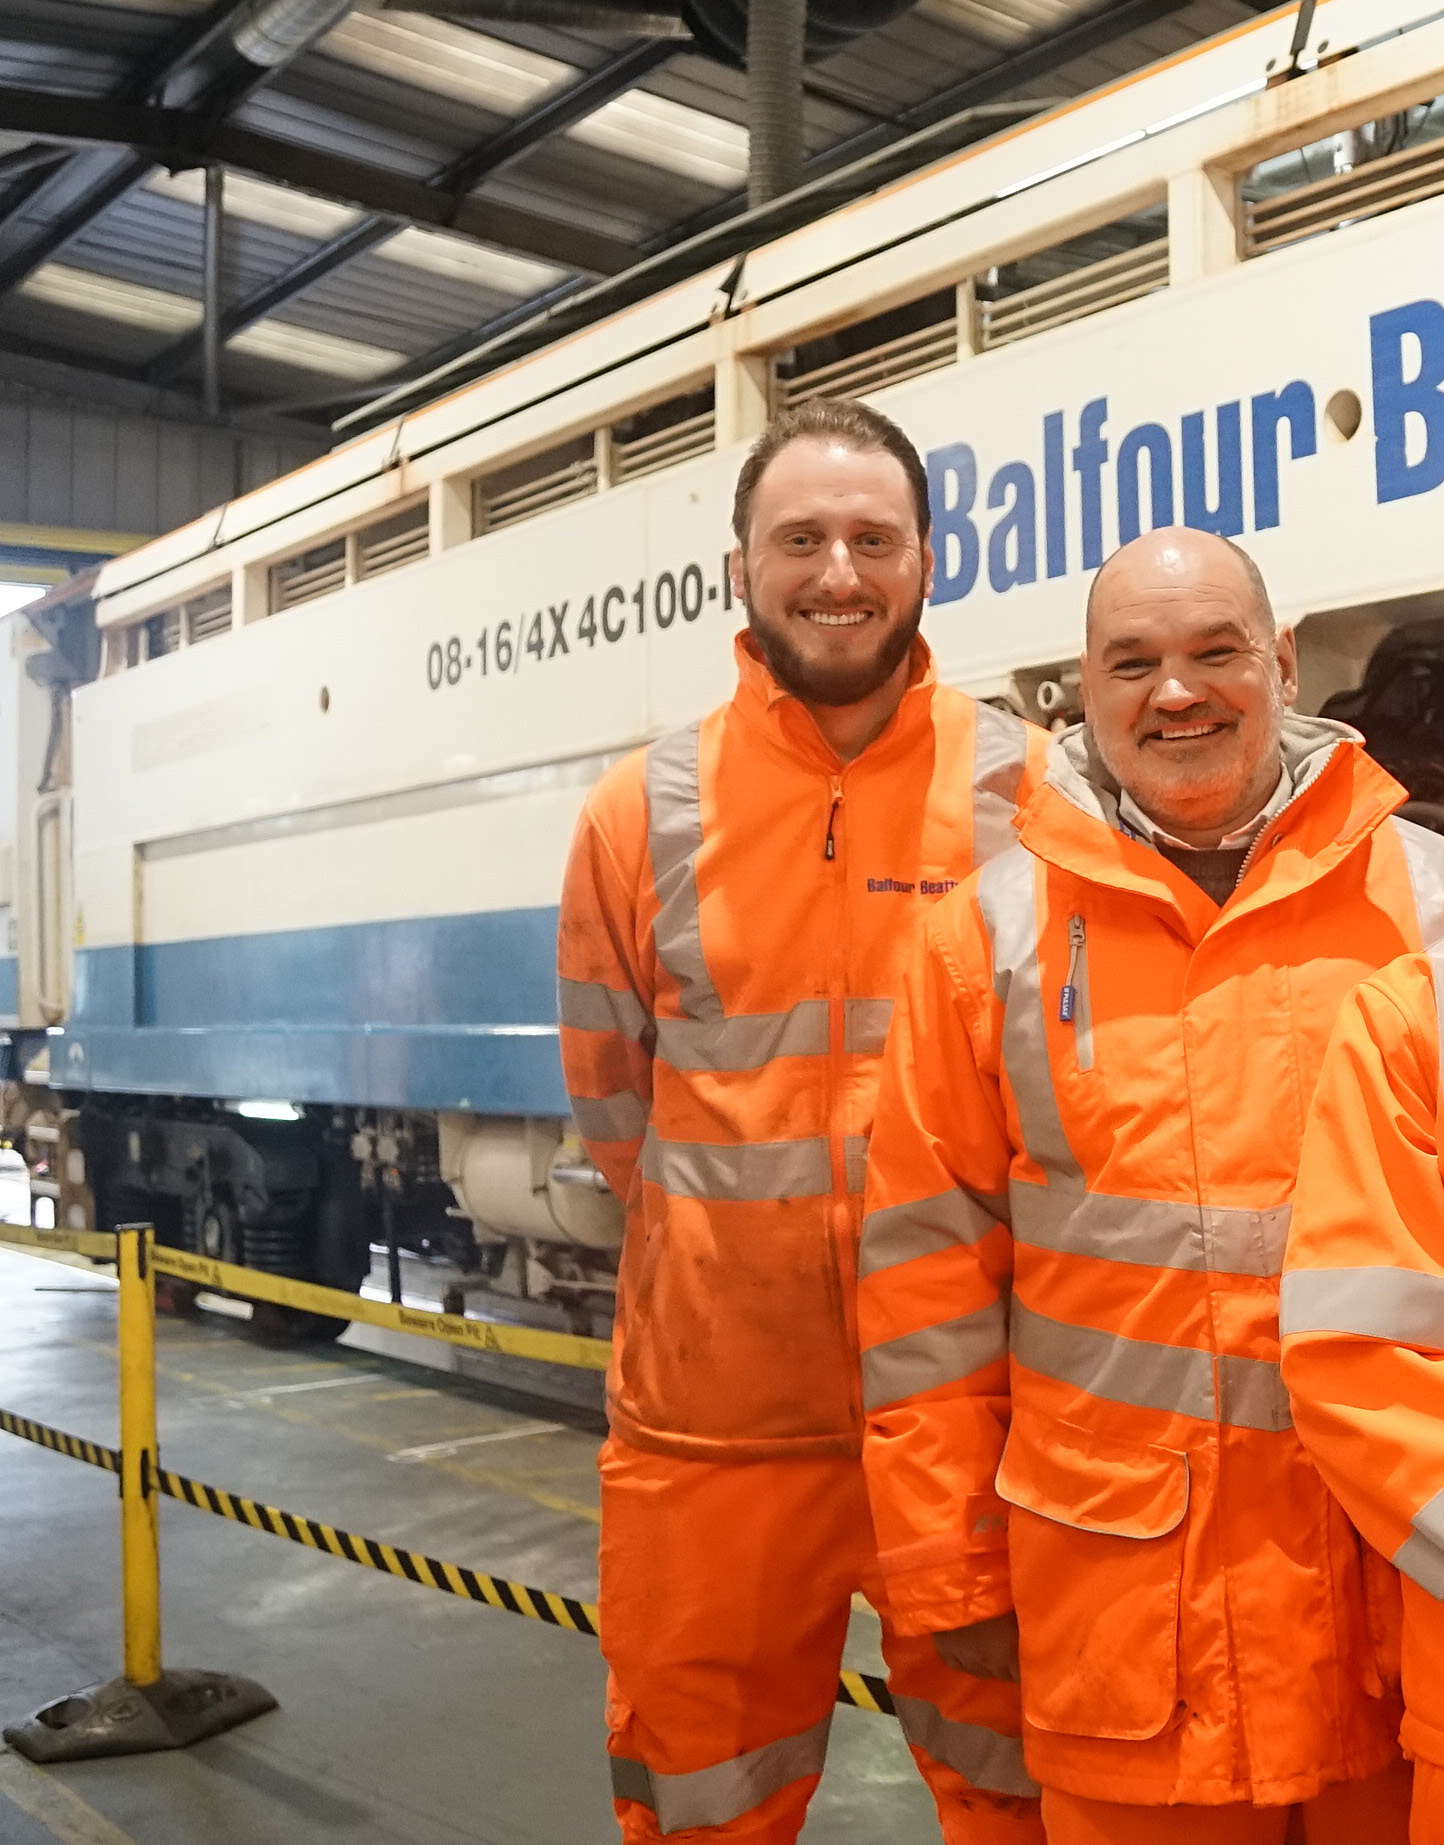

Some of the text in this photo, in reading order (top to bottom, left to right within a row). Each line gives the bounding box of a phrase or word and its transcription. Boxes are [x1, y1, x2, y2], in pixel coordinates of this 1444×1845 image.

[925, 380, 1318, 606] Balfour
[867, 878, 959, 895] Balfour Beatt
